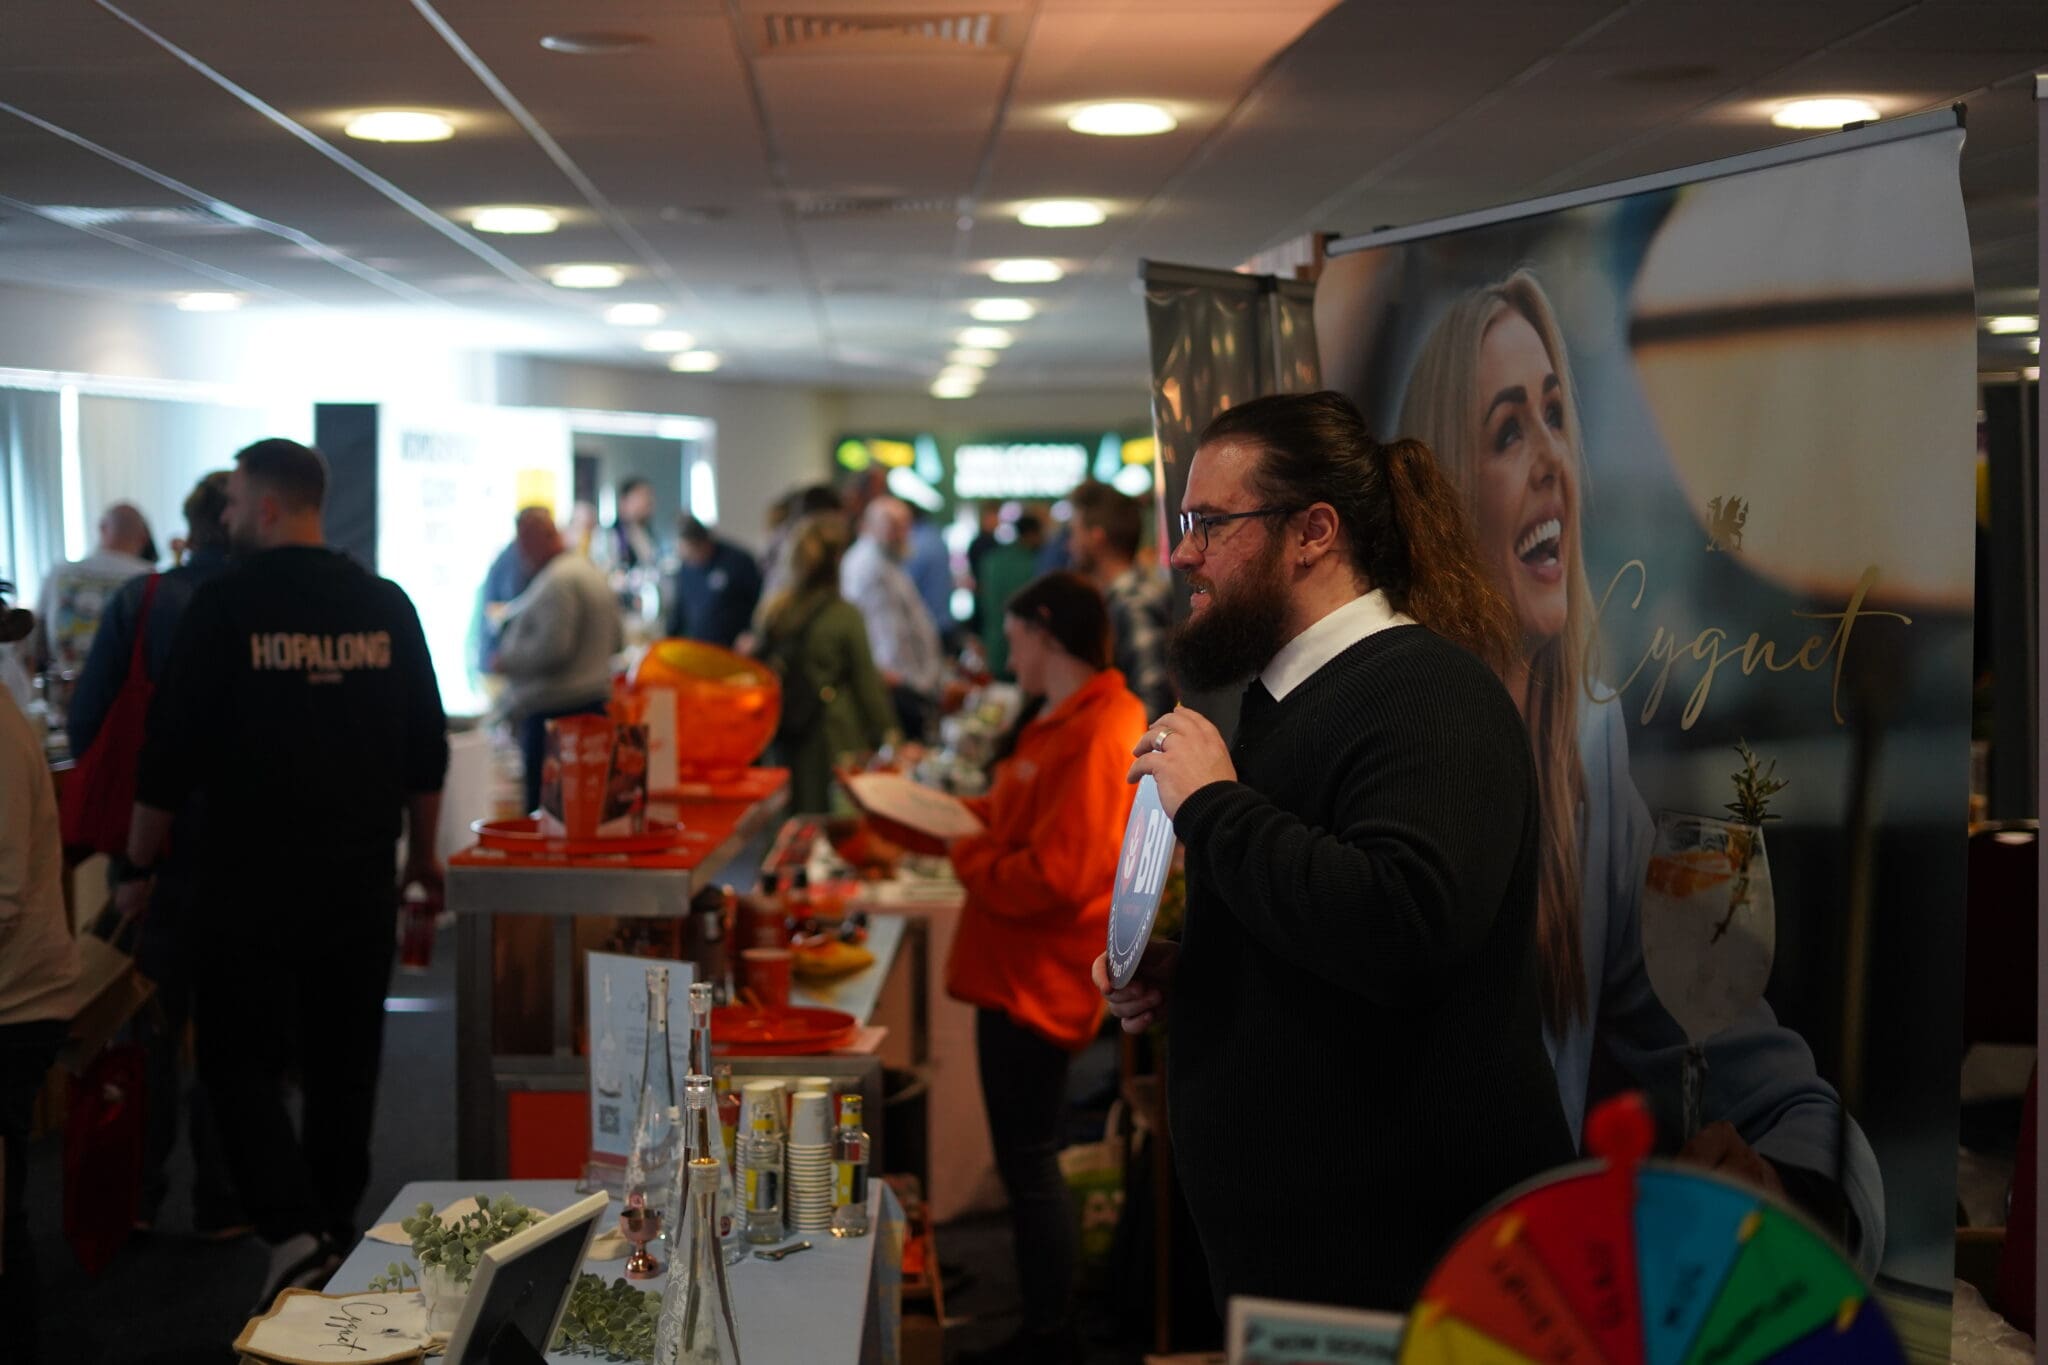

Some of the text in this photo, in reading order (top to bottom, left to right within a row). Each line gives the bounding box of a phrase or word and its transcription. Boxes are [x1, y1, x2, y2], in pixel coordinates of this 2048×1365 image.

[251, 631, 391, 671] HOPALONG
[1582, 559, 1912, 731] Cygnet
[318, 1302, 388, 1355] Cygnet
